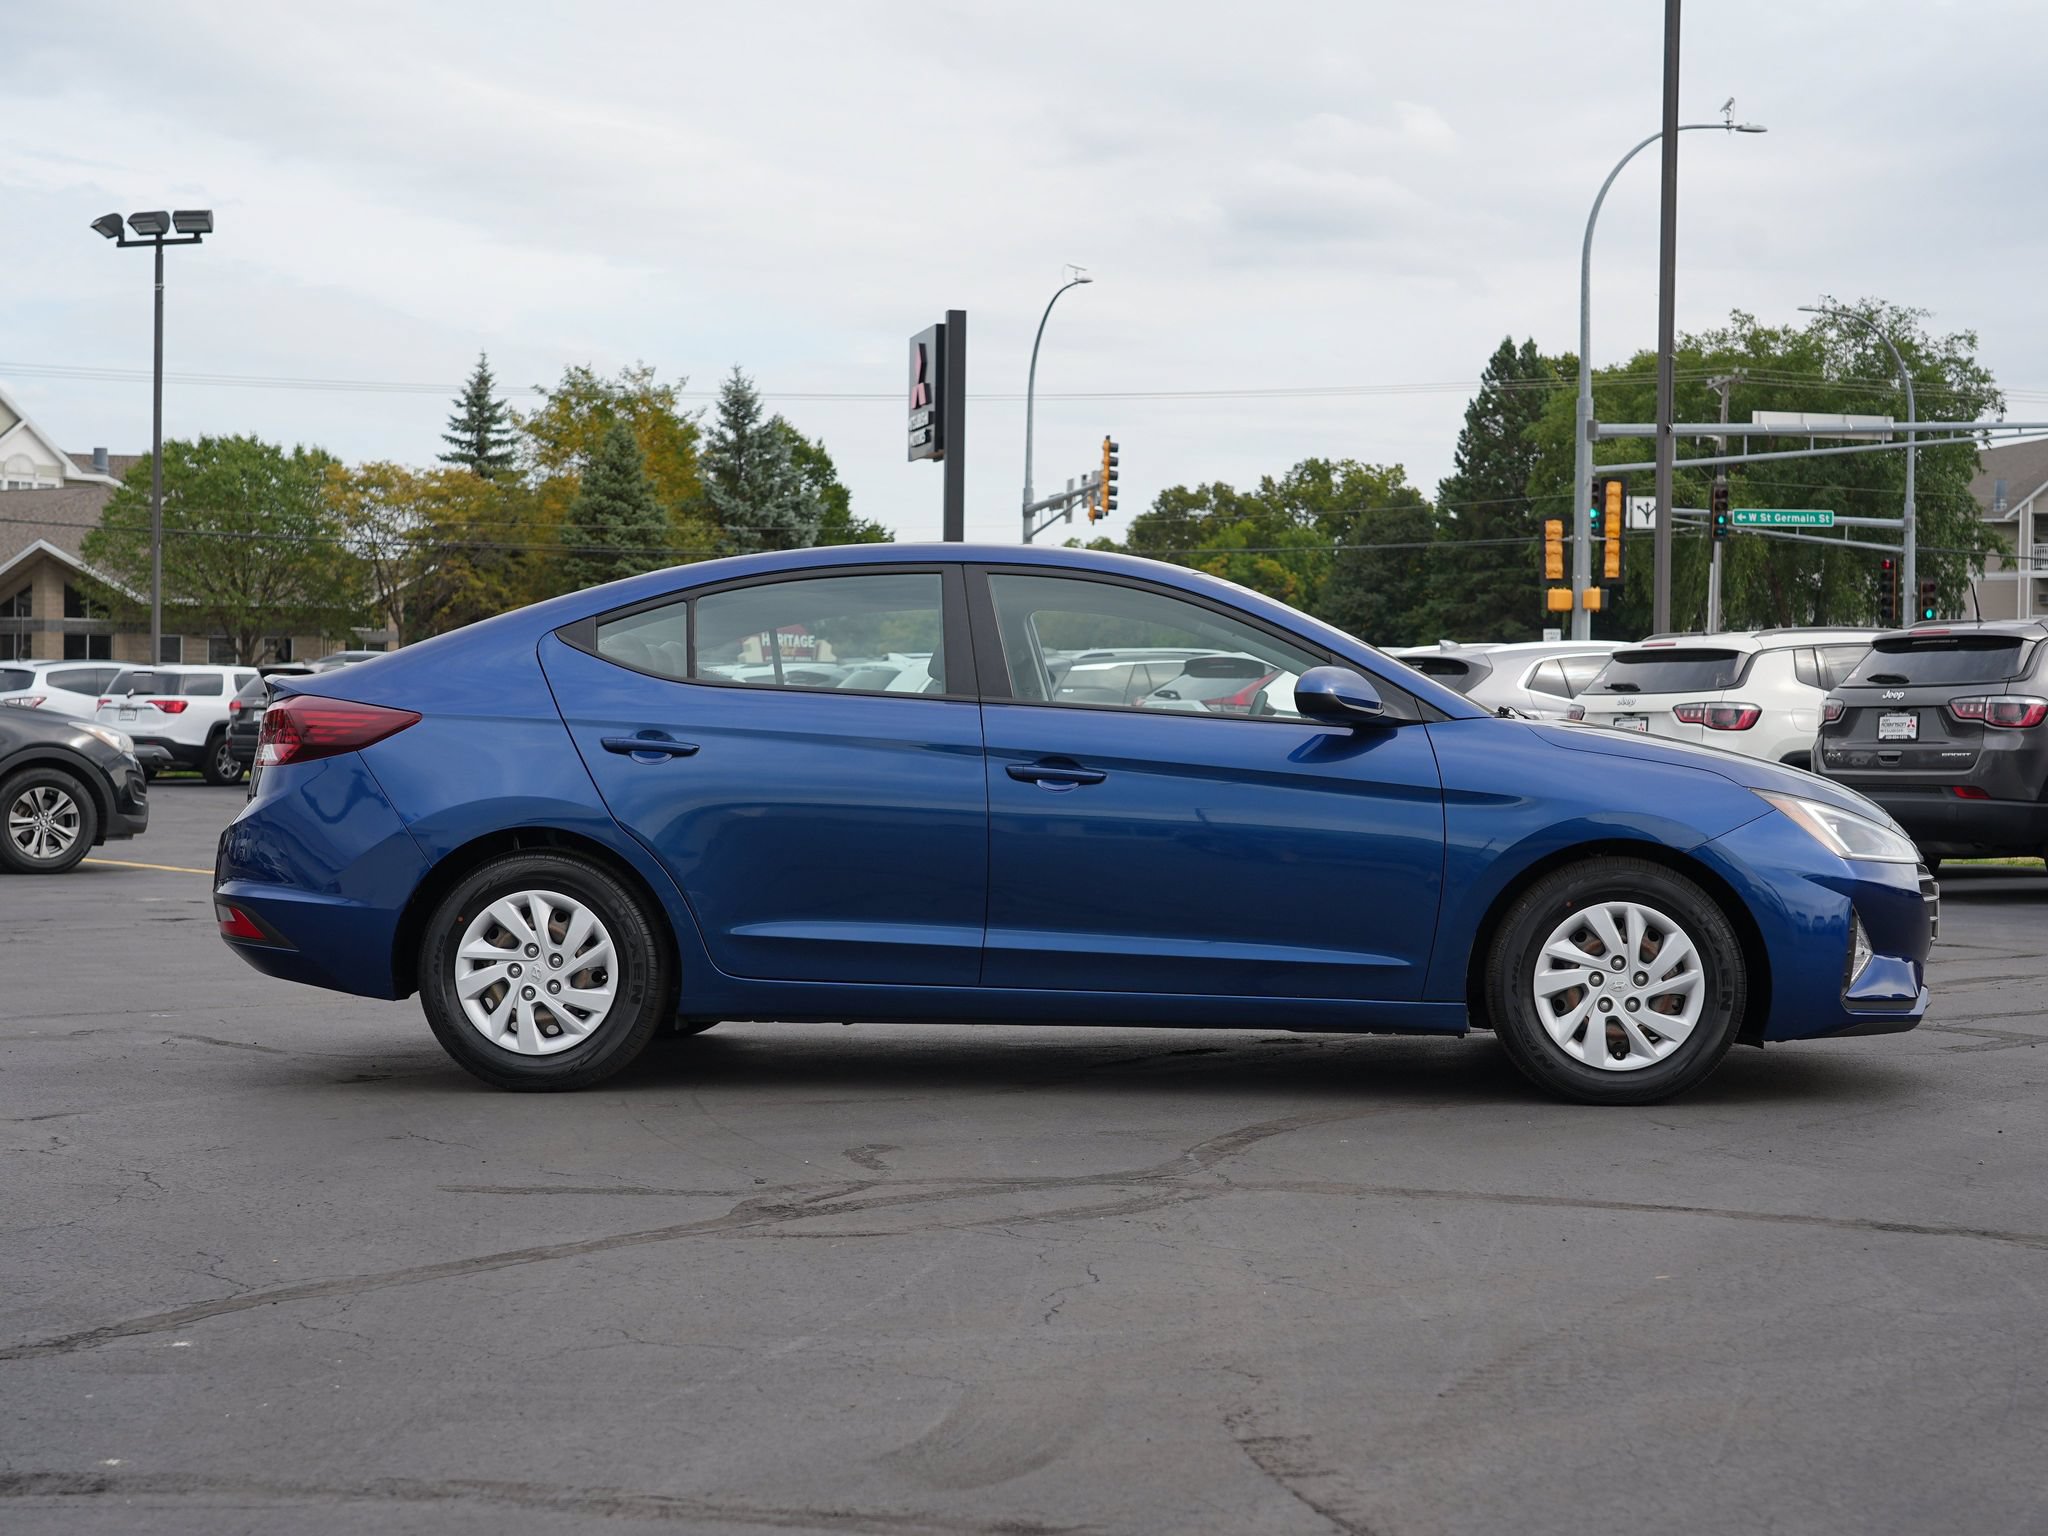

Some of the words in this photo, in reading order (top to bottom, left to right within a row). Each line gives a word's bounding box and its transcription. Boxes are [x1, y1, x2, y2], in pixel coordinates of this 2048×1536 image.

[1748, 513, 1757, 522] W
[1760, 513, 1771, 522] St
[1774, 513, 1816, 523] Germain
[1818, 514, 1830, 523] St
[761, 630, 815, 648] HRITAGE
[1882, 689, 1905, 700] Jeep
